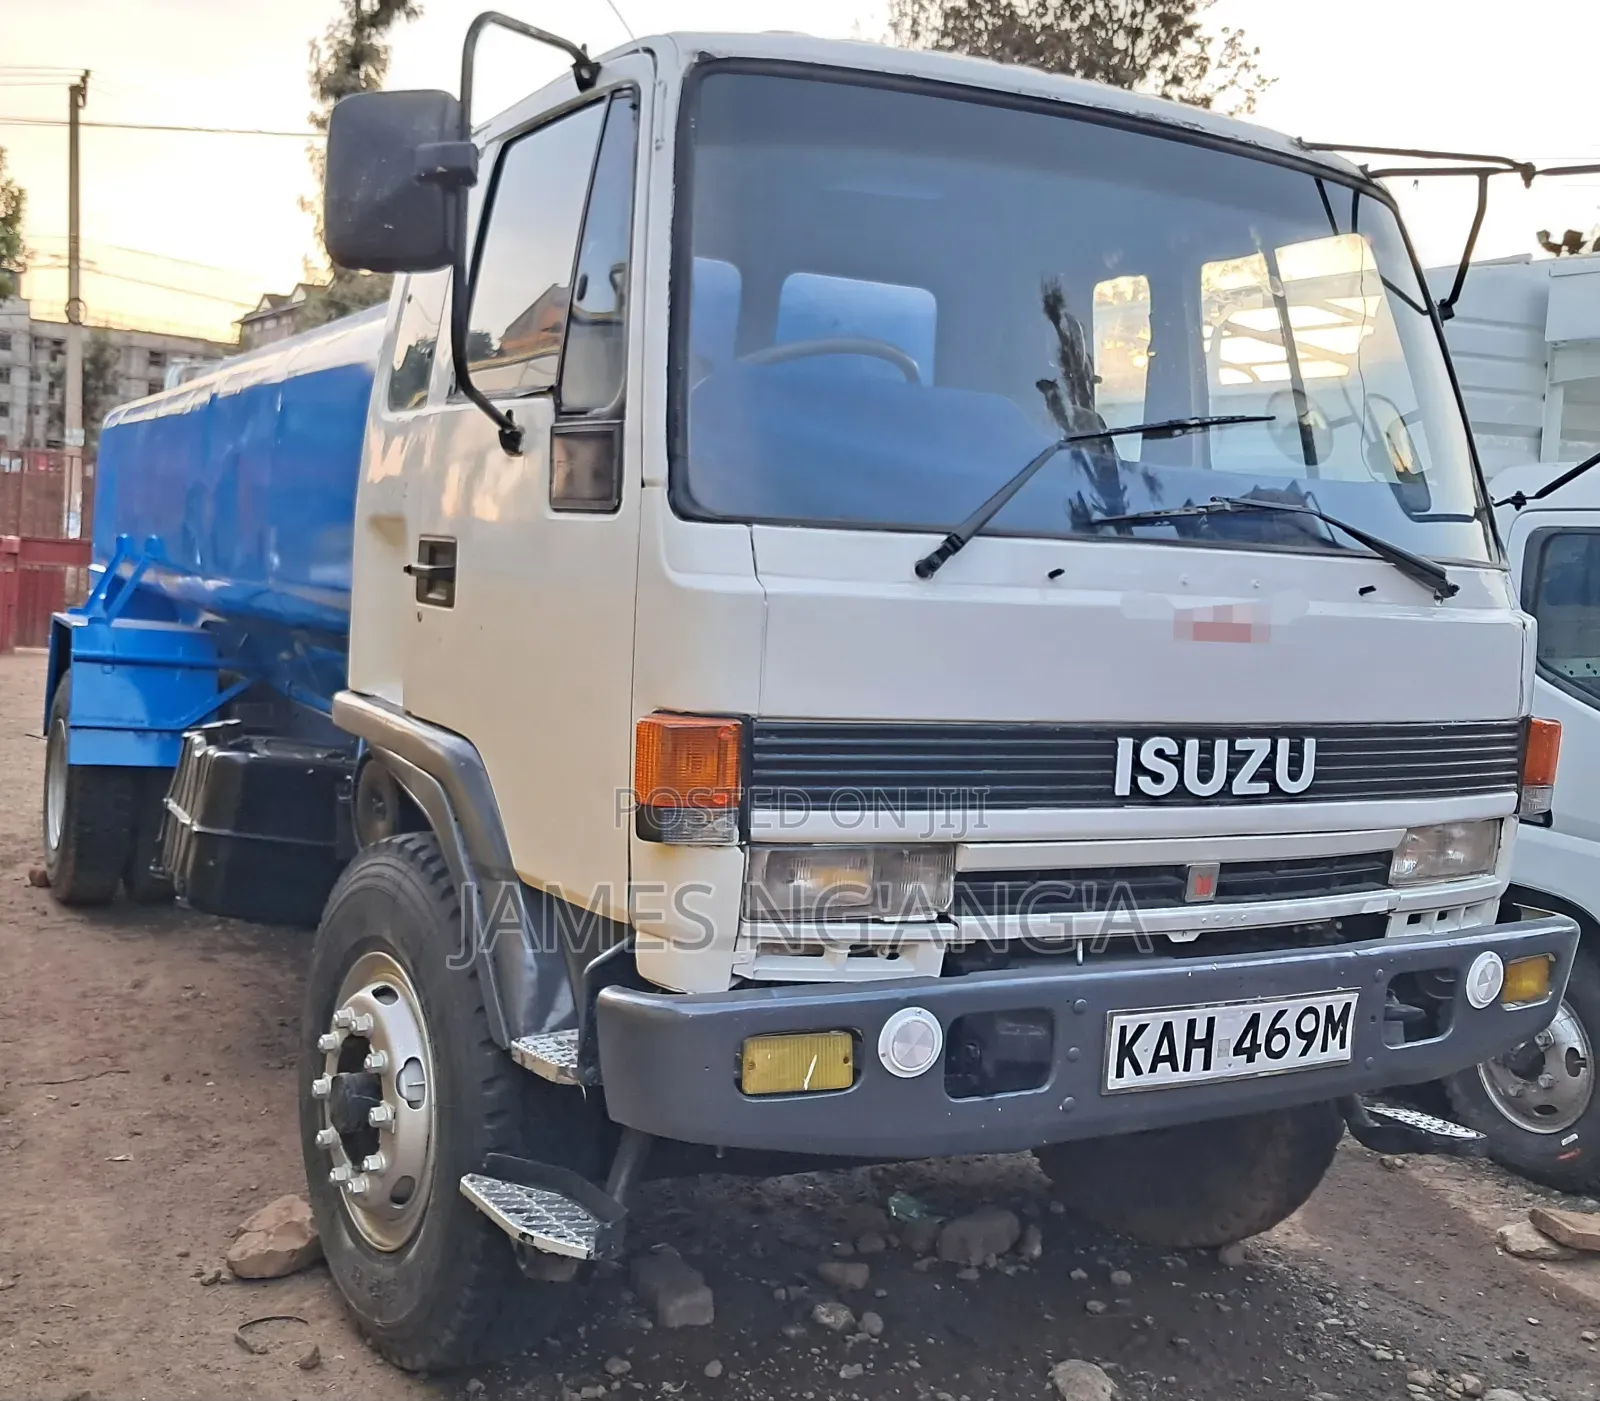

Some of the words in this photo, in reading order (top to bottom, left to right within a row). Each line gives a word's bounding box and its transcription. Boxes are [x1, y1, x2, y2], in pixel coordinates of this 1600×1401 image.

[1115, 736, 1317, 797] ISUZU
[1115, 1015, 1217, 1079] KAH
[1232, 1001, 1353, 1064] 469M
